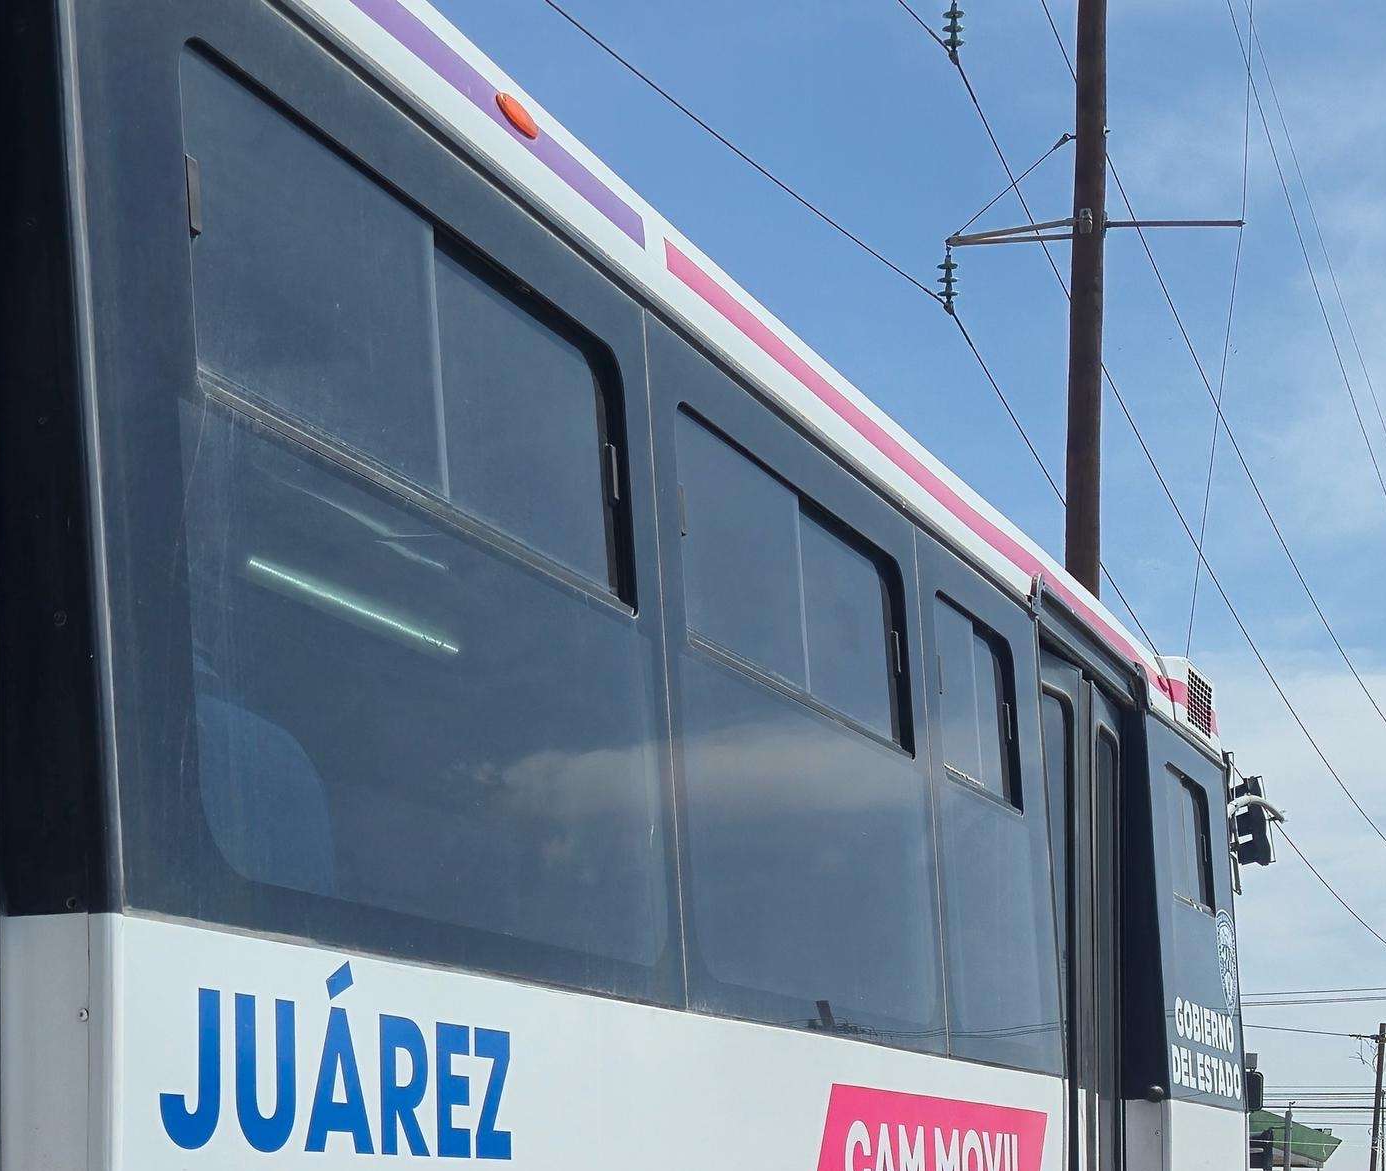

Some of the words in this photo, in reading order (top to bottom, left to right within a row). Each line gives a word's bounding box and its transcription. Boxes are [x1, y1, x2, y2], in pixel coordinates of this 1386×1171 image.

[1175, 996, 1234, 1054] GOBIERNO
[159, 960, 512, 1160] JUÁREZ
[1171, 1044, 1197, 1090] DEL
[1197, 1052, 1242, 1101] ESTADO
